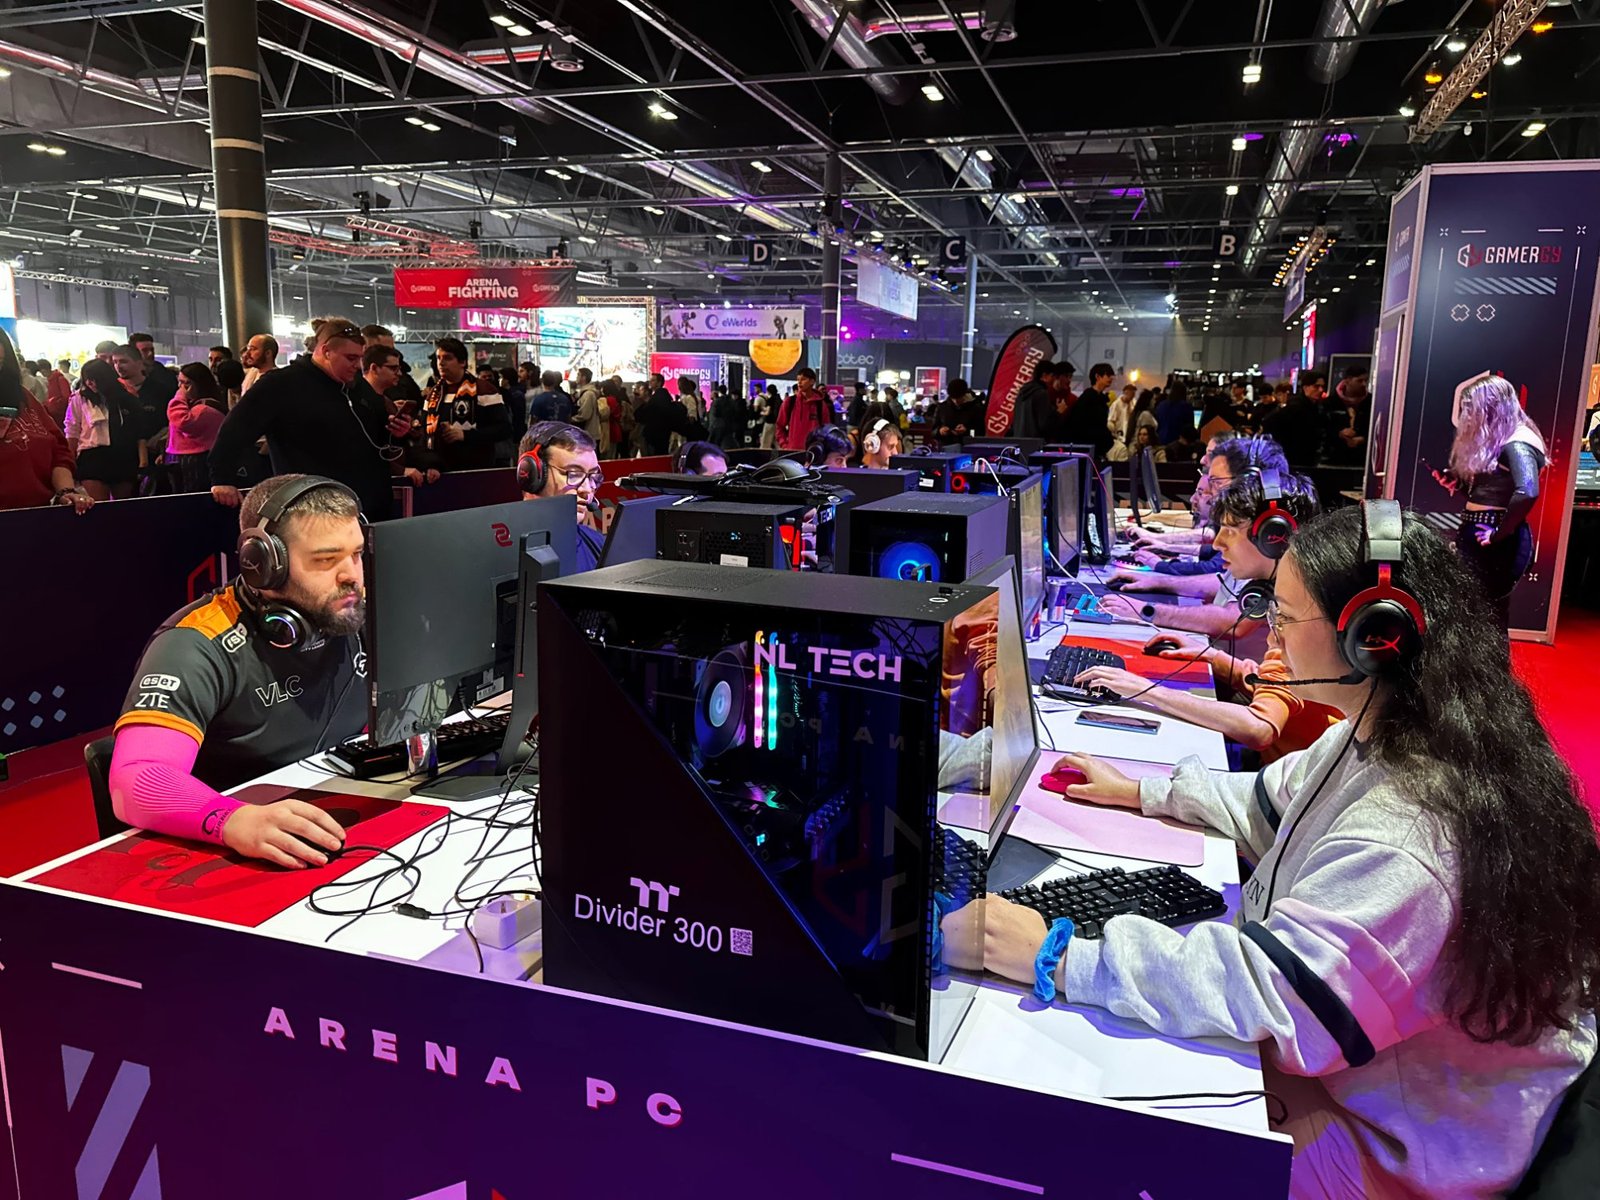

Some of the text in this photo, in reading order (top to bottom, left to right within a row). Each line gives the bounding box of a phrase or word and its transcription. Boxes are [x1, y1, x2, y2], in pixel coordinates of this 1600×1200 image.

[753, 243, 768, 262] D
[945, 240, 961, 260] C
[1220, 235, 1236, 256] B
[1485, 246, 1562, 264] GAMERGY
[466, 278, 500, 286] ARENA
[448, 287, 519, 298] FIGHTING
[754, 643, 902, 682] NL TECH
[134, 692, 170, 708] ZTE
[255, 675, 304, 707] VLC
[574, 893, 723, 952] Divider 300
[264, 1006, 682, 1127] ARENA PC
